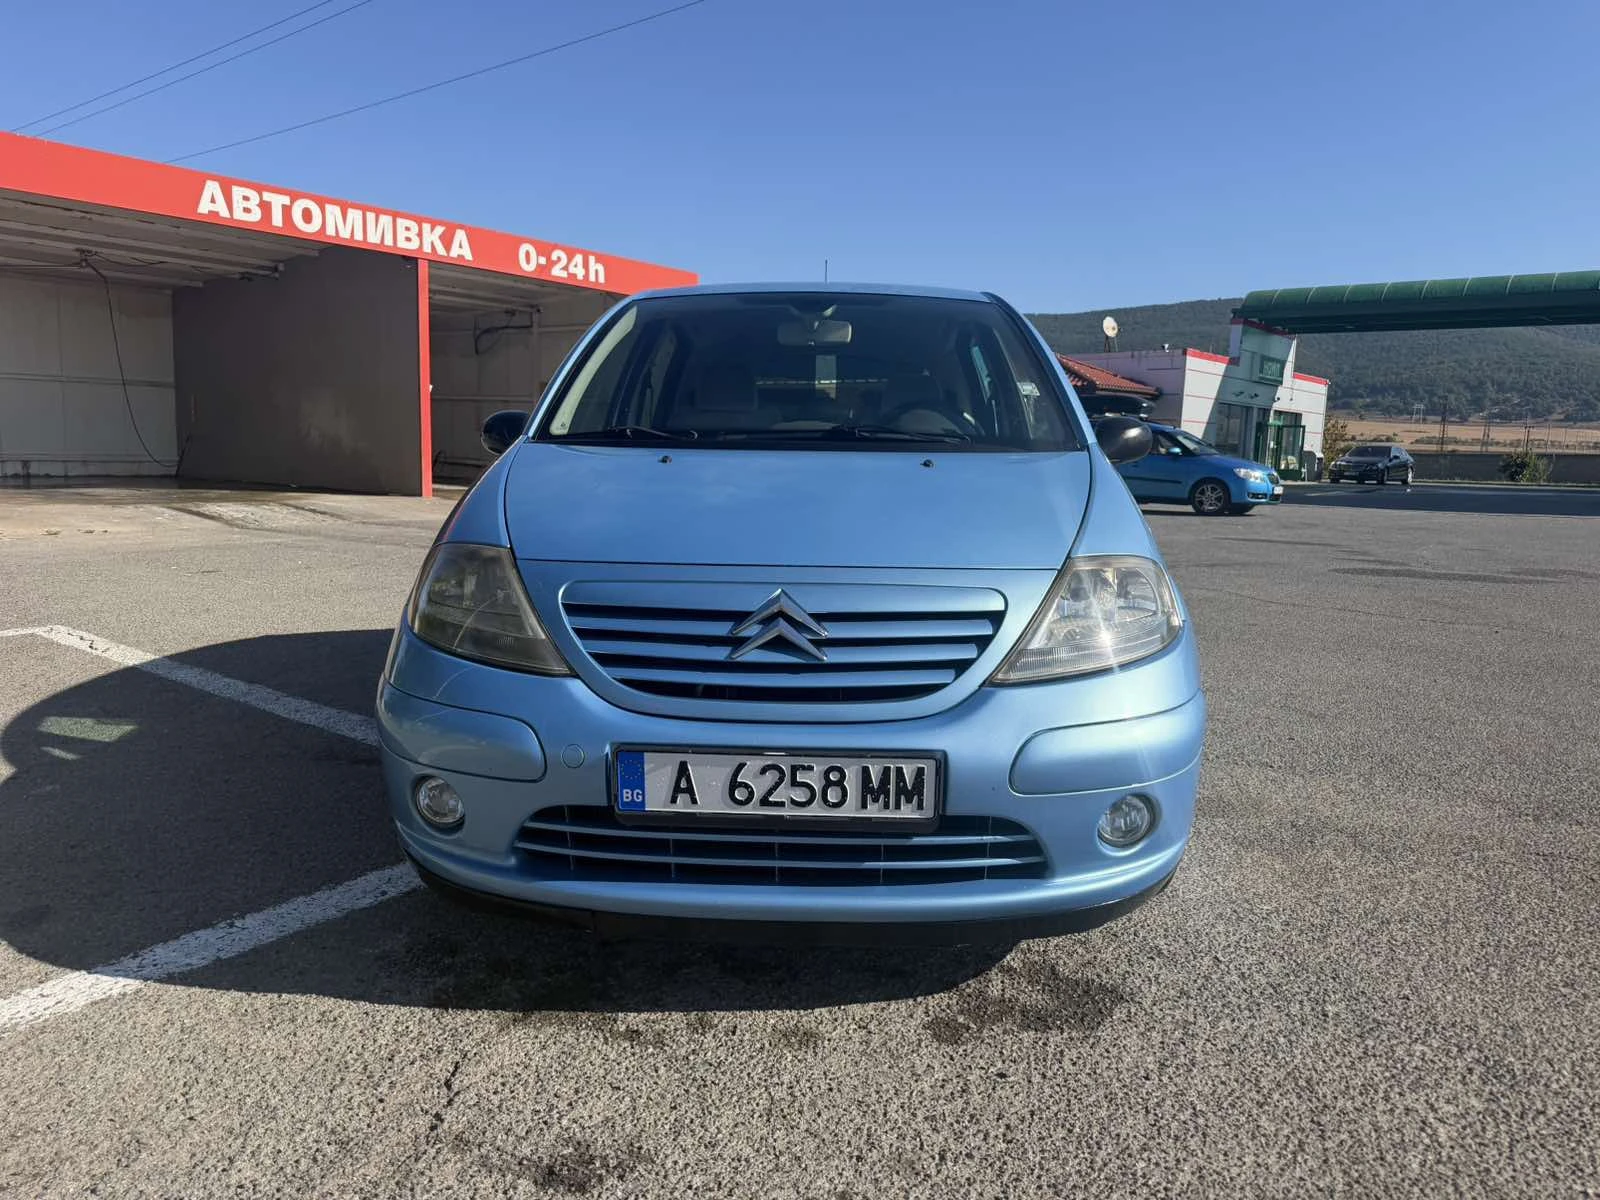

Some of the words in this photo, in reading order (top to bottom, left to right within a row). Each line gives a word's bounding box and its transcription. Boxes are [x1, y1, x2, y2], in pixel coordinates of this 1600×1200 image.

[197, 179, 473, 261] АВТОМИВКА
[623, 789, 643, 802] BG
[728, 762, 849, 809] 6258
